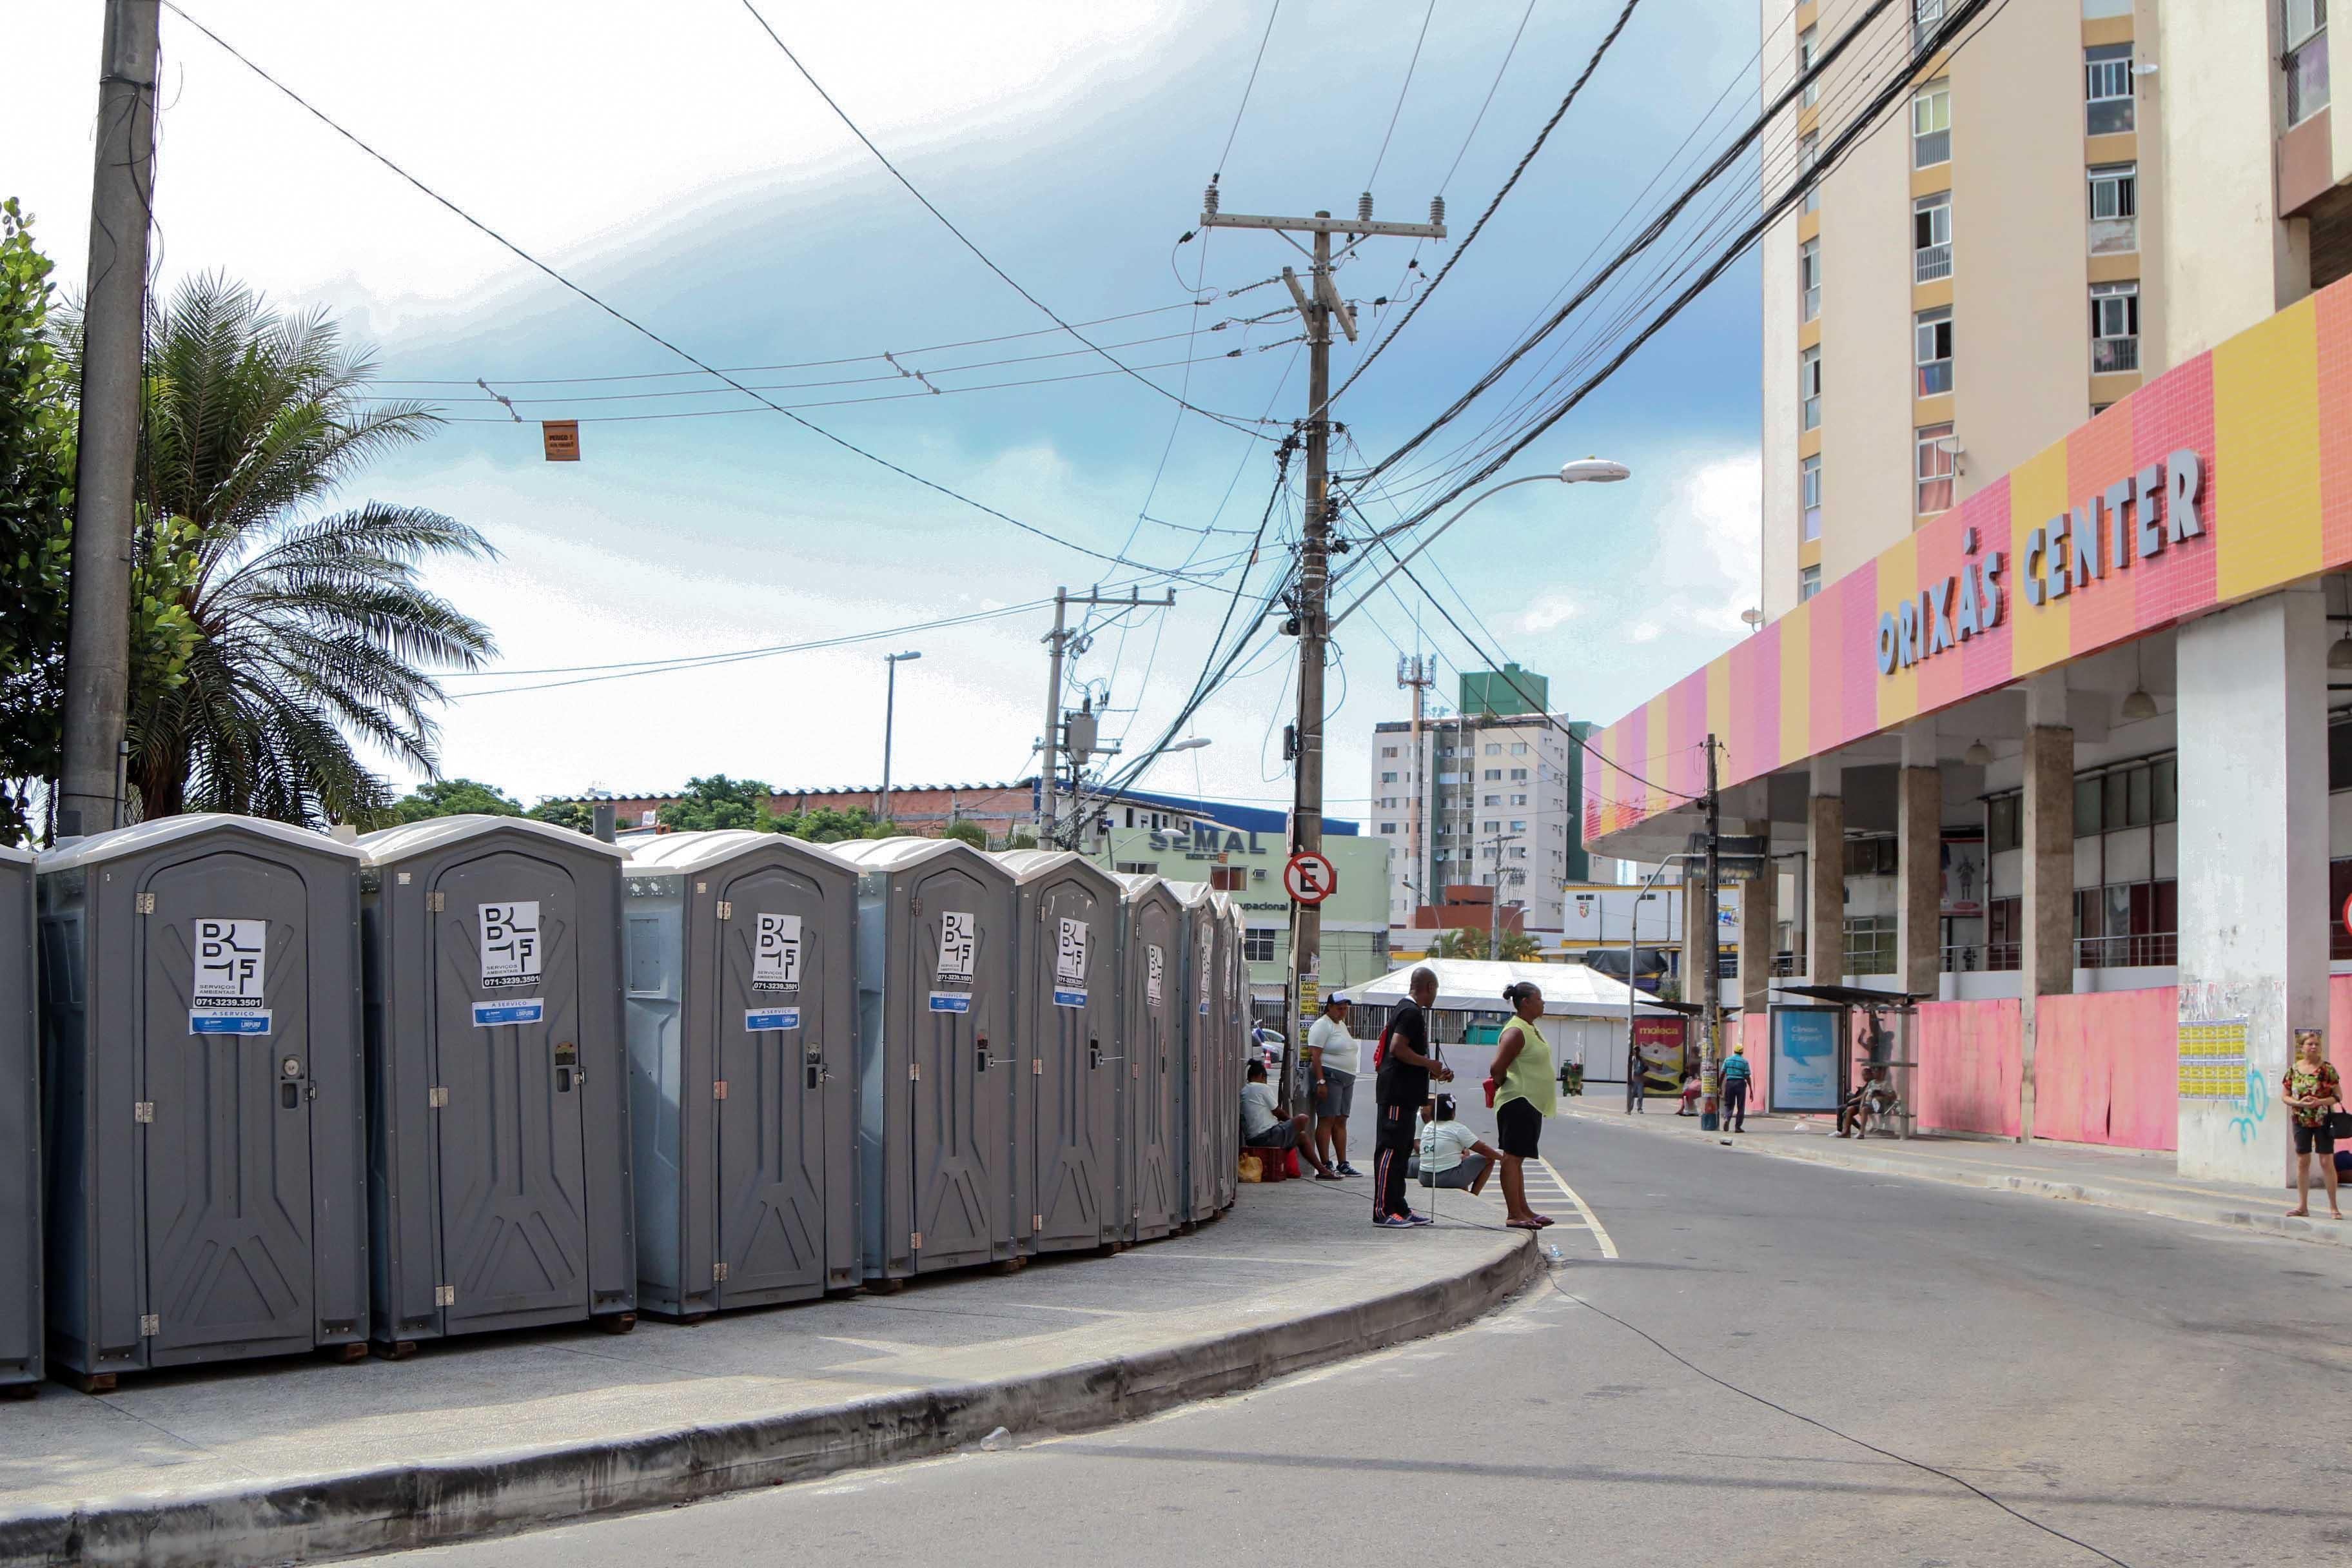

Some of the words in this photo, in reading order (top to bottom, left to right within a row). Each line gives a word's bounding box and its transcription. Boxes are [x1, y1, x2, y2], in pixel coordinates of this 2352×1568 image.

[1877, 526, 2003, 676] ORIXÁS
[2023, 449, 2206, 607] CENTER
[1149, 828, 1267, 854] SEMAL
[1300, 863, 1319, 892] E
[1238, 901, 1288, 912] upacional
[484, 975, 540, 986] 071-3239.3501
[195, 998, 261, 1006] 071-3239.3501
[1640, 1026, 1679, 1035] moleca
